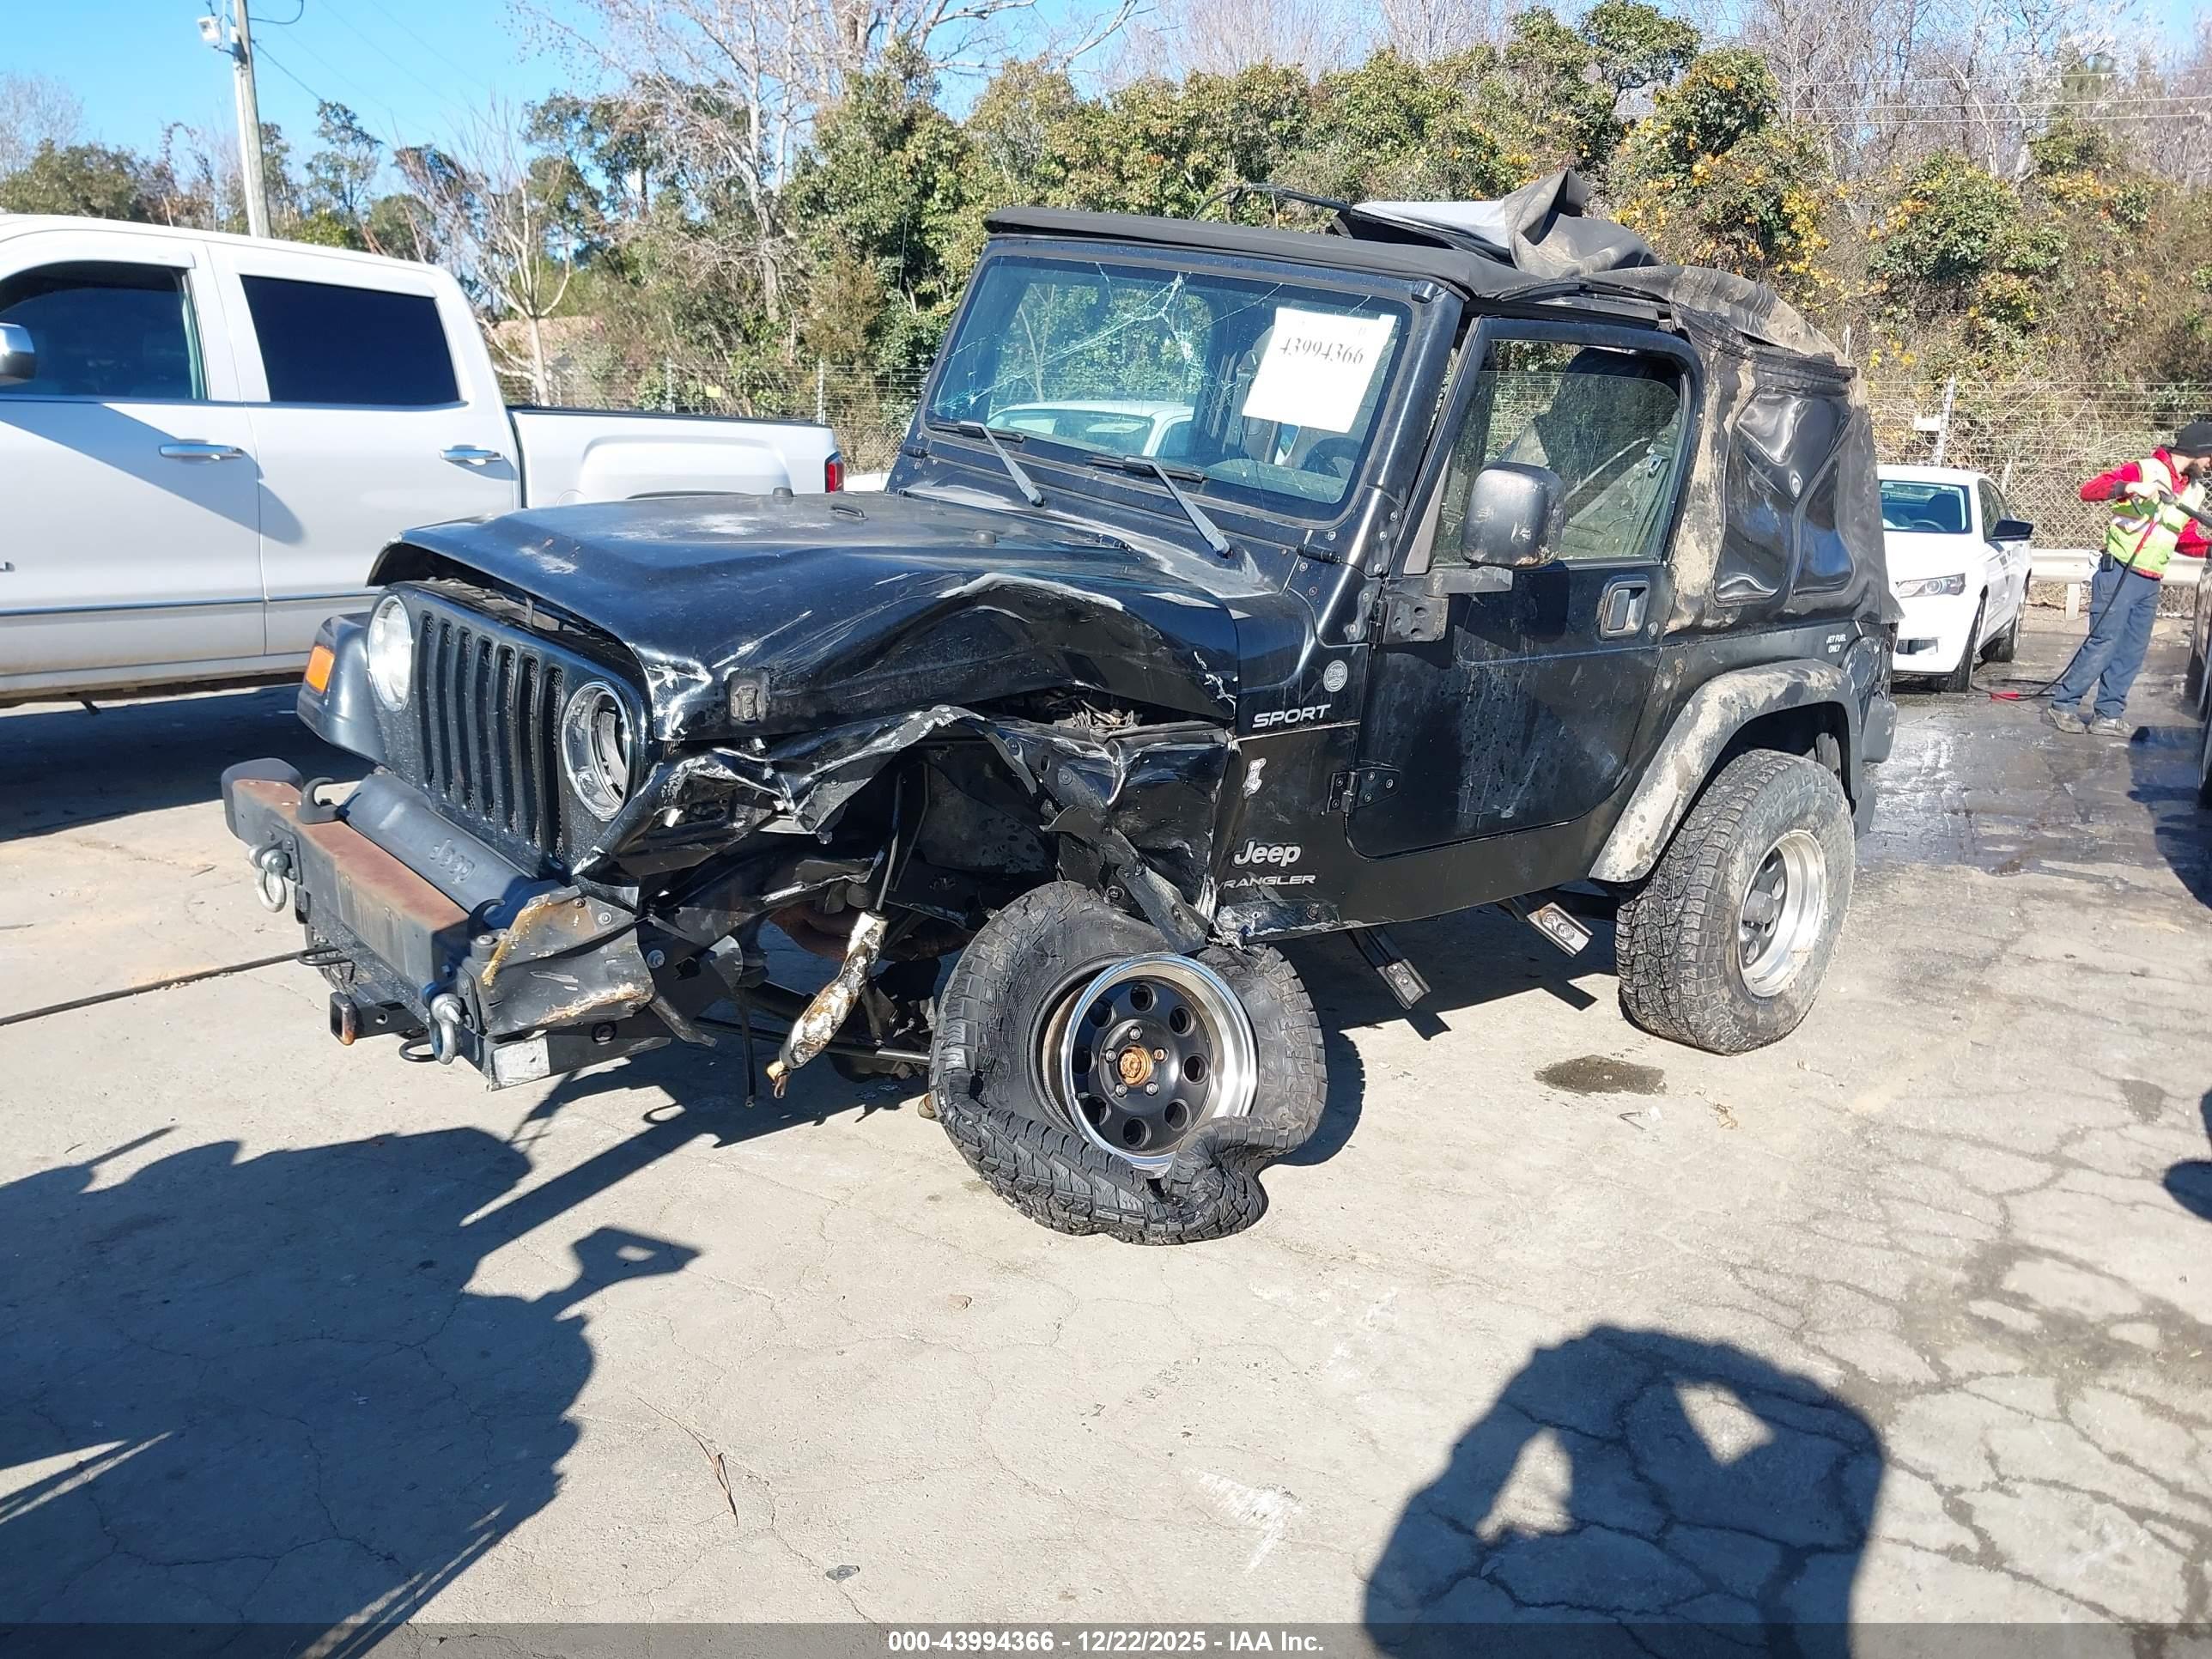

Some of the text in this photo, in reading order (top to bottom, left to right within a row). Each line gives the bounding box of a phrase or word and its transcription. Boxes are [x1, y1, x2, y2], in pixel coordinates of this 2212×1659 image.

[1279, 337, 1364, 365] 43994366
[1828, 644, 1841, 653] ONLY
[1252, 704, 1331, 728] SPORT
[1234, 842, 1301, 867] Jeep
